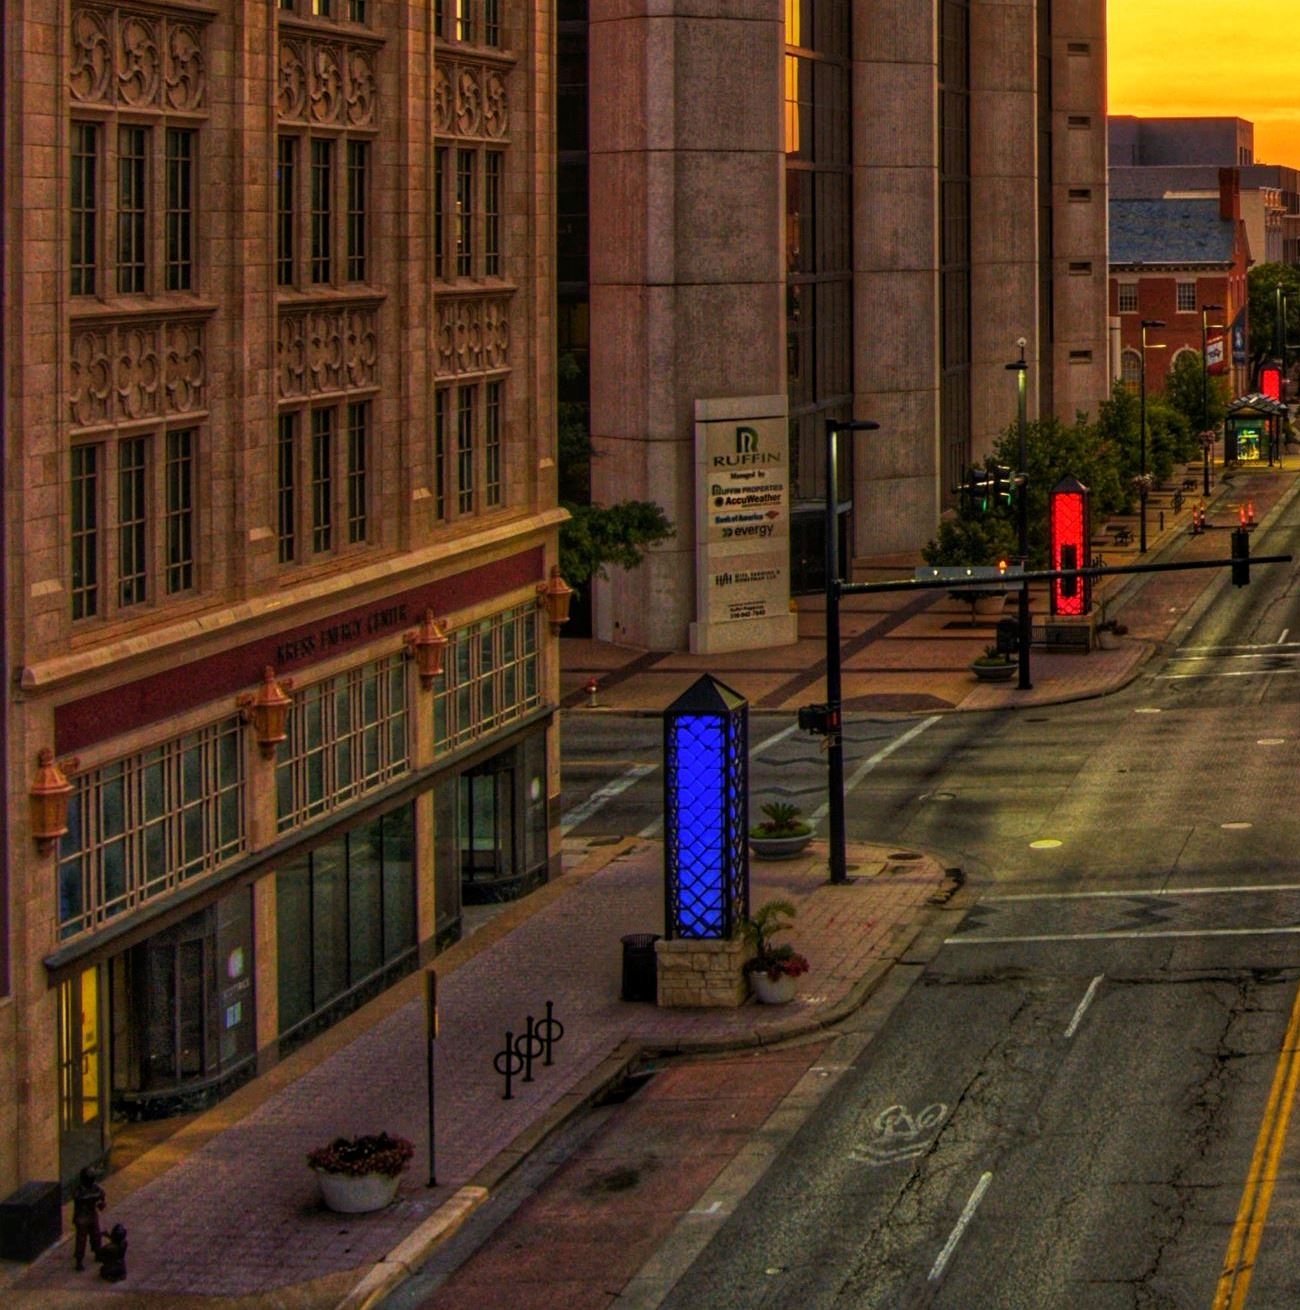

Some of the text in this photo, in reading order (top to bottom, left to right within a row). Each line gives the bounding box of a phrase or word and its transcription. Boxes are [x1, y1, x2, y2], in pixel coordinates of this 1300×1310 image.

[714, 452, 780, 466] RUFFIN
[725, 494, 781, 505] AccuWeather
[734, 524, 774, 537] evergy
